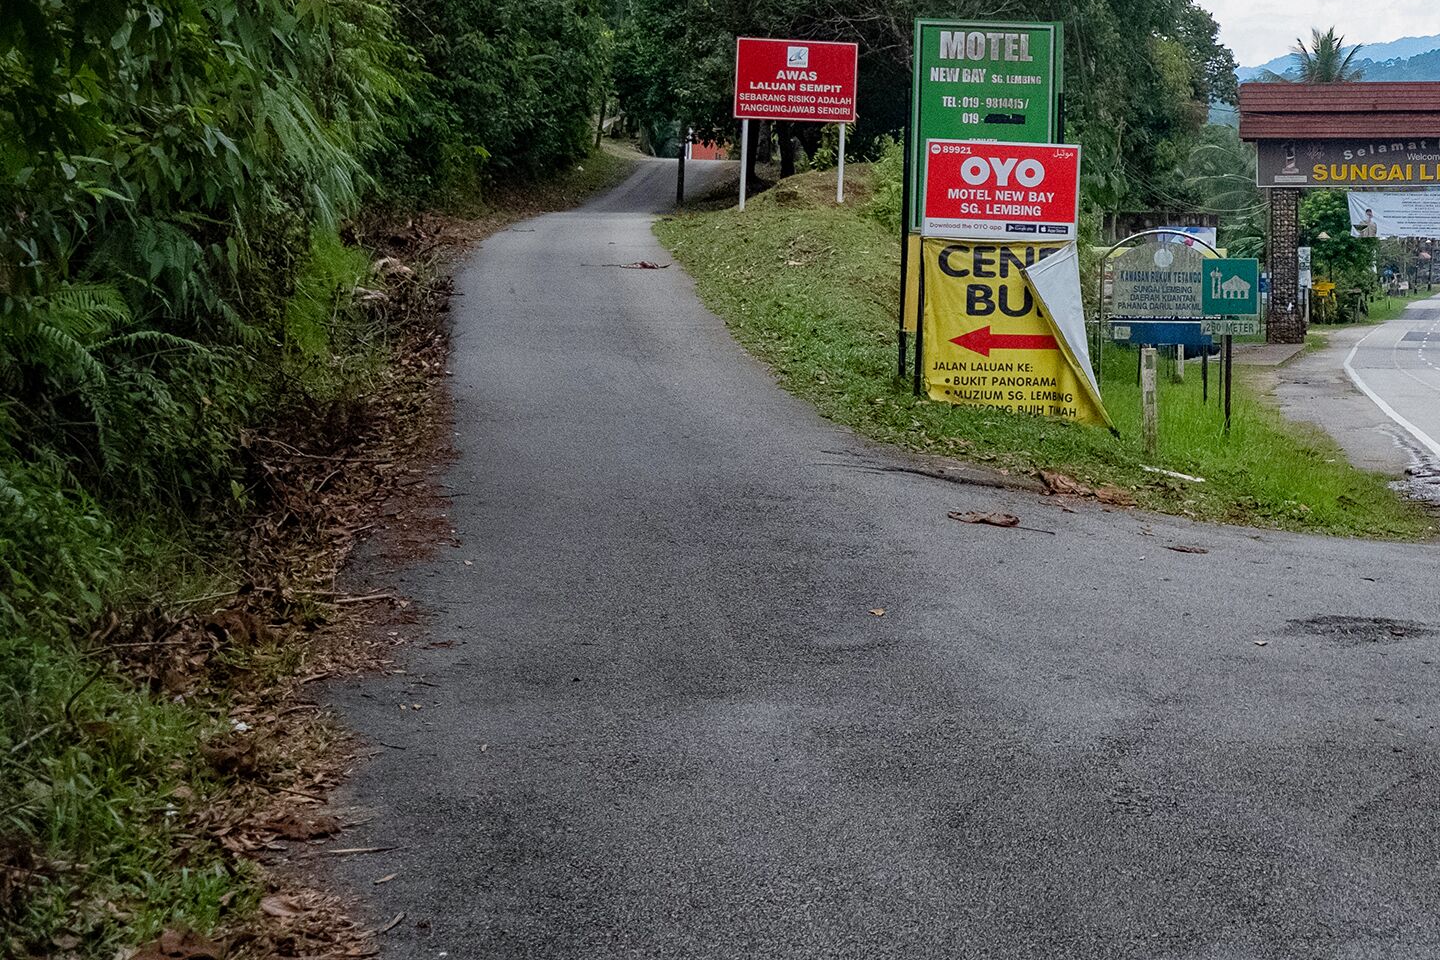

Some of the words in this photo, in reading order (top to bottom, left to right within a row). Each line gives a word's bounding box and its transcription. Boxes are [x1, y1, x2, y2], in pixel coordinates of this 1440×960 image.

[939, 31, 1033, 62] MOTEL
[776, 70, 818, 81] AWAS
[930, 67, 960, 82] NEW
[962, 68, 987, 83] BAY
[1006, 75, 1042, 85] LEMBING
[750, 81, 796, 91] LALUAN
[799, 83, 842, 93] SEMPIT
[739, 93, 786, 102] SEBARANG
[787, 95, 816, 103] RISIKO
[817, 96, 852, 105] ADALAH
[740, 103, 816, 113] TANGGUNGJAWAB
[817, 106, 851, 115] SENDIRI
[942, 146, 972, 155] 89921
[1343, 140, 1427, 160] Selamat
[960, 156, 1045, 188] OYO
[1312, 163, 1413, 181] SUNGAI
[948, 189, 991, 201] MOTEL
[995, 190, 1025, 202] NEW
[1028, 191, 1055, 203] BAY
[960, 203, 982, 214] SG.
[986, 204, 1042, 217] LEMBING
[1226, 323, 1254, 333] METER
[933, 361, 967, 371] JALAN
[971, 362, 1013, 372] LALUAN
[1017, 363, 1034, 373] KE:
[953, 376, 987, 386] BUKIT
[992, 377, 1057, 387] PANORAMA
[953, 390, 1003, 400] MUZIUM
[1008, 391, 1026, 401] SG.
